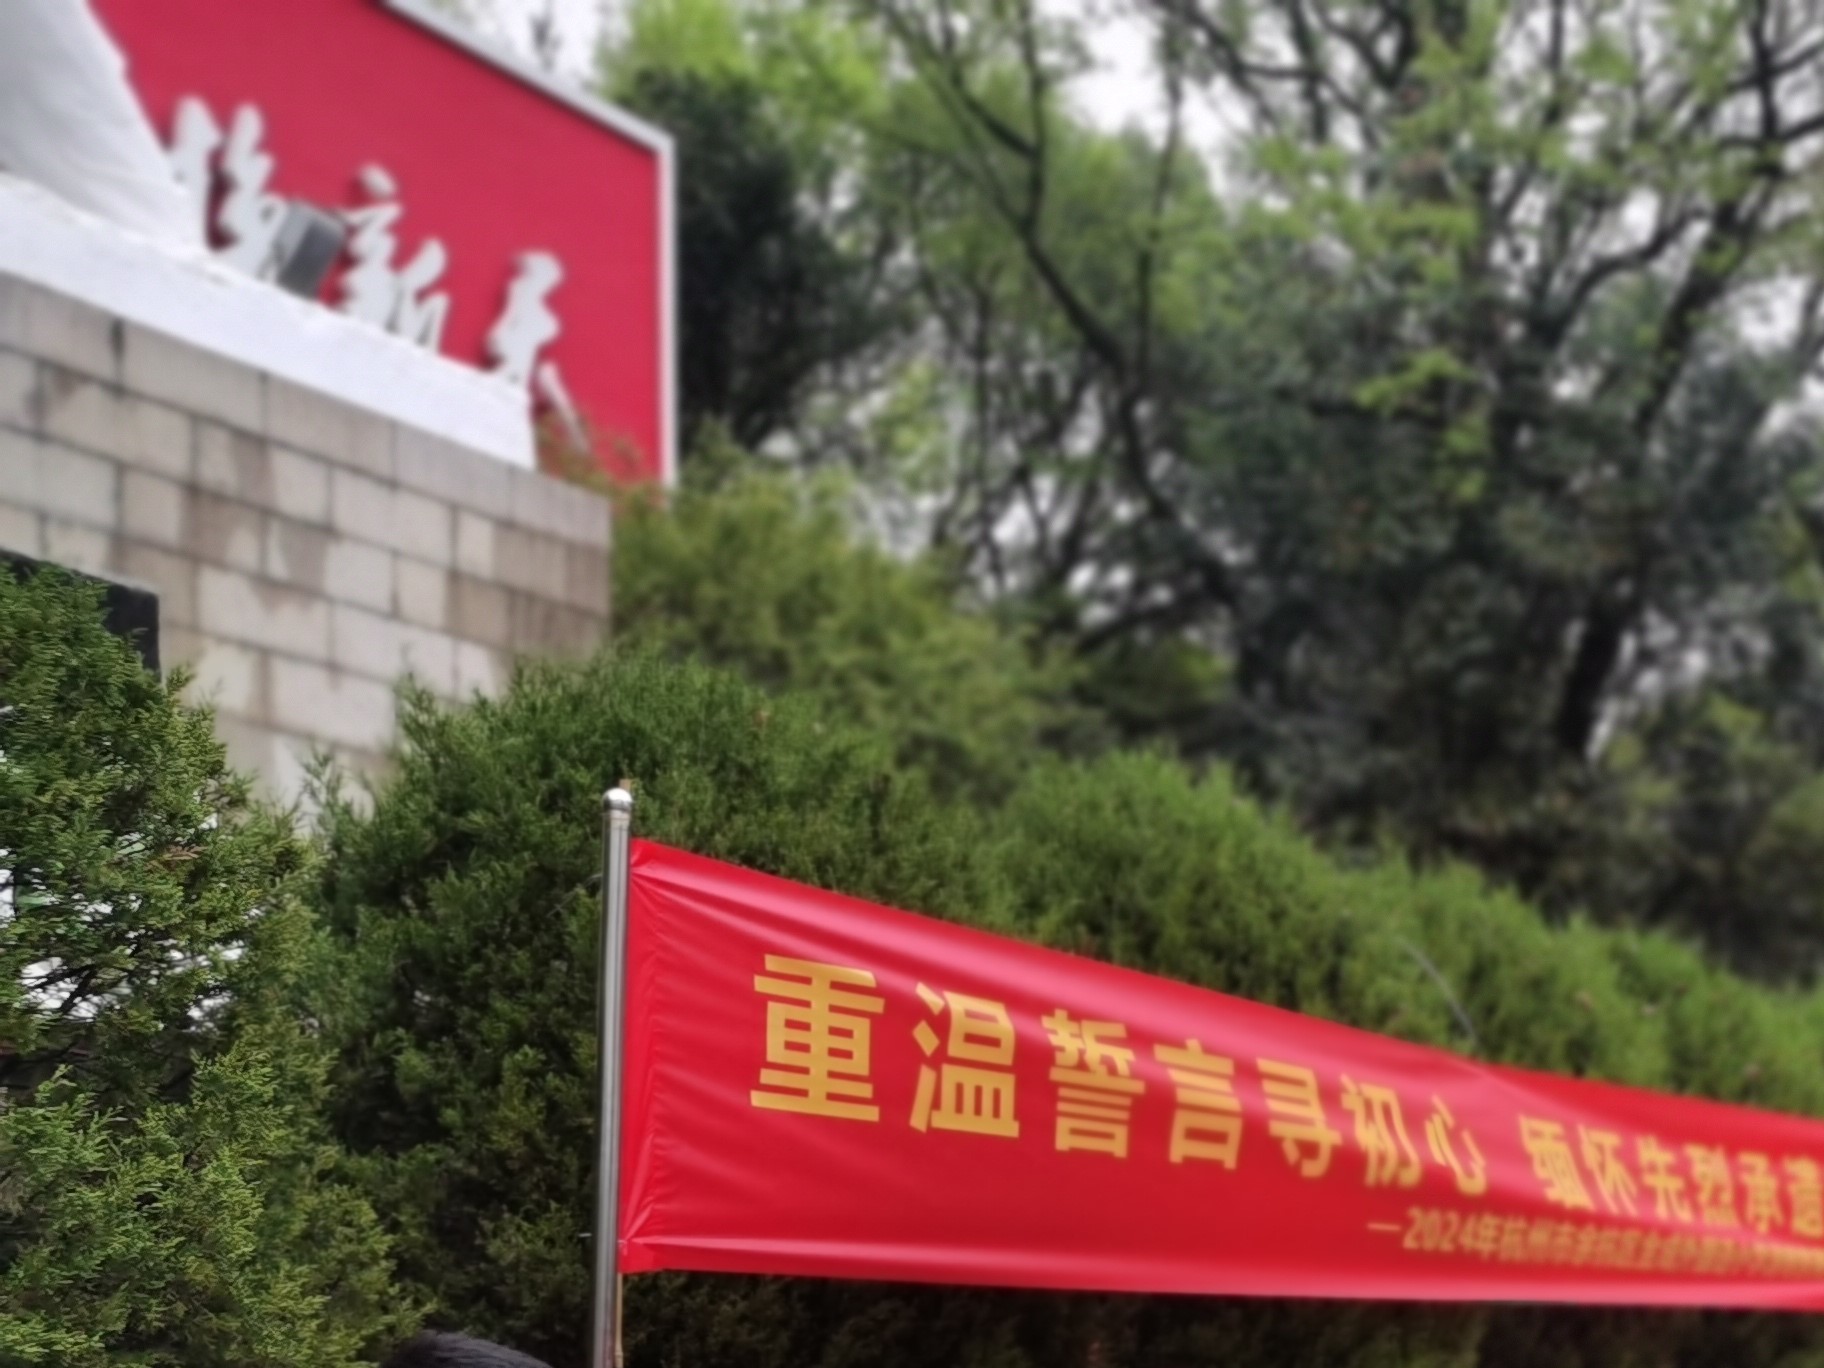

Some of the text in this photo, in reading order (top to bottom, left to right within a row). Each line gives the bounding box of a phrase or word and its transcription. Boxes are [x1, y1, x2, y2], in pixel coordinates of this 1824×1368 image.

[750, 953, 1487, 1196] 重温誓言寻初心
